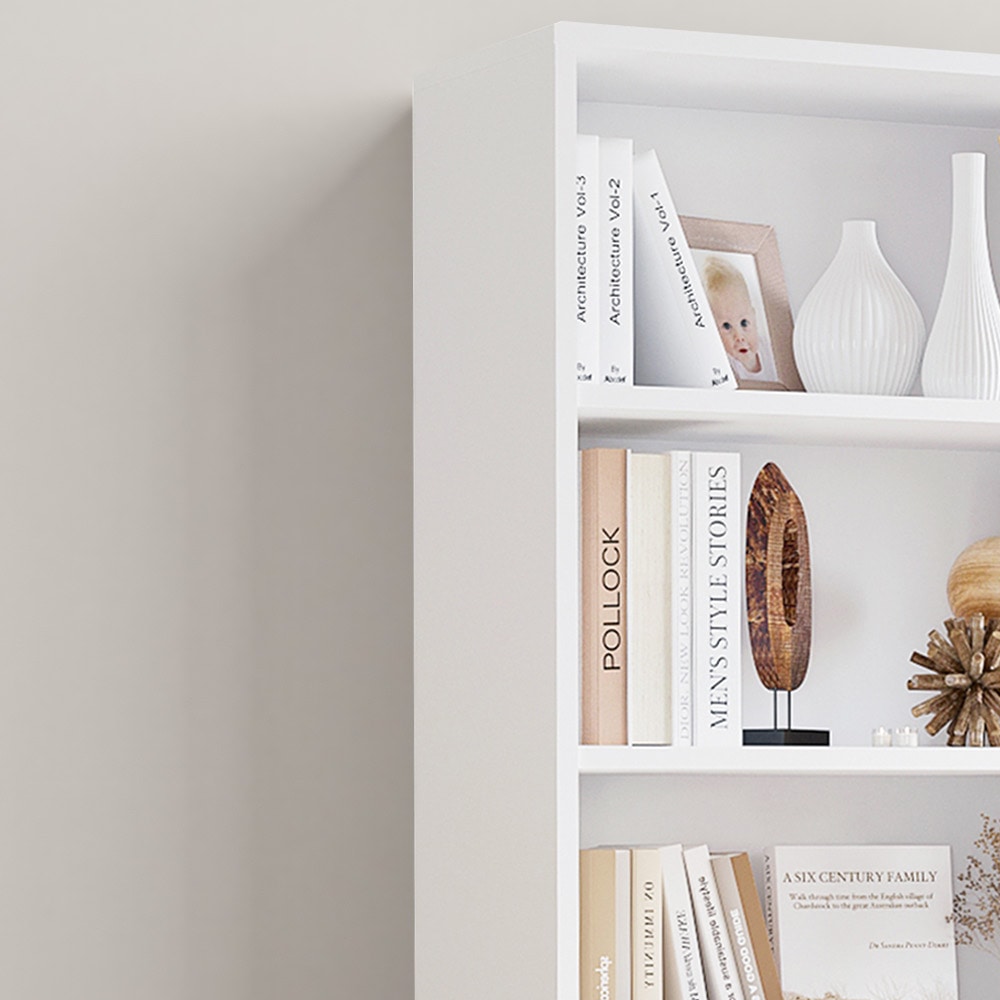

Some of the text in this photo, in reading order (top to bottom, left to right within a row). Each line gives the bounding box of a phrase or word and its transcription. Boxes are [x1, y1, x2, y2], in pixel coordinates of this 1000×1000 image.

[576, 175, 588, 218] Vol-3
[609, 178, 621, 325] Architecture Vol-2
[650, 192, 706, 328] Architecture Vol-1
[679, 459, 688, 580] REVOLUTION
[601, 527, 621, 671] POLLOCK
[680, 586, 689, 637] LOOK
[709, 466, 728, 729] MEN'S STYLE STORIES
[680, 642, 689, 684] NEW
[782, 871, 938, 883] A SIX CENTURY FAMILY
